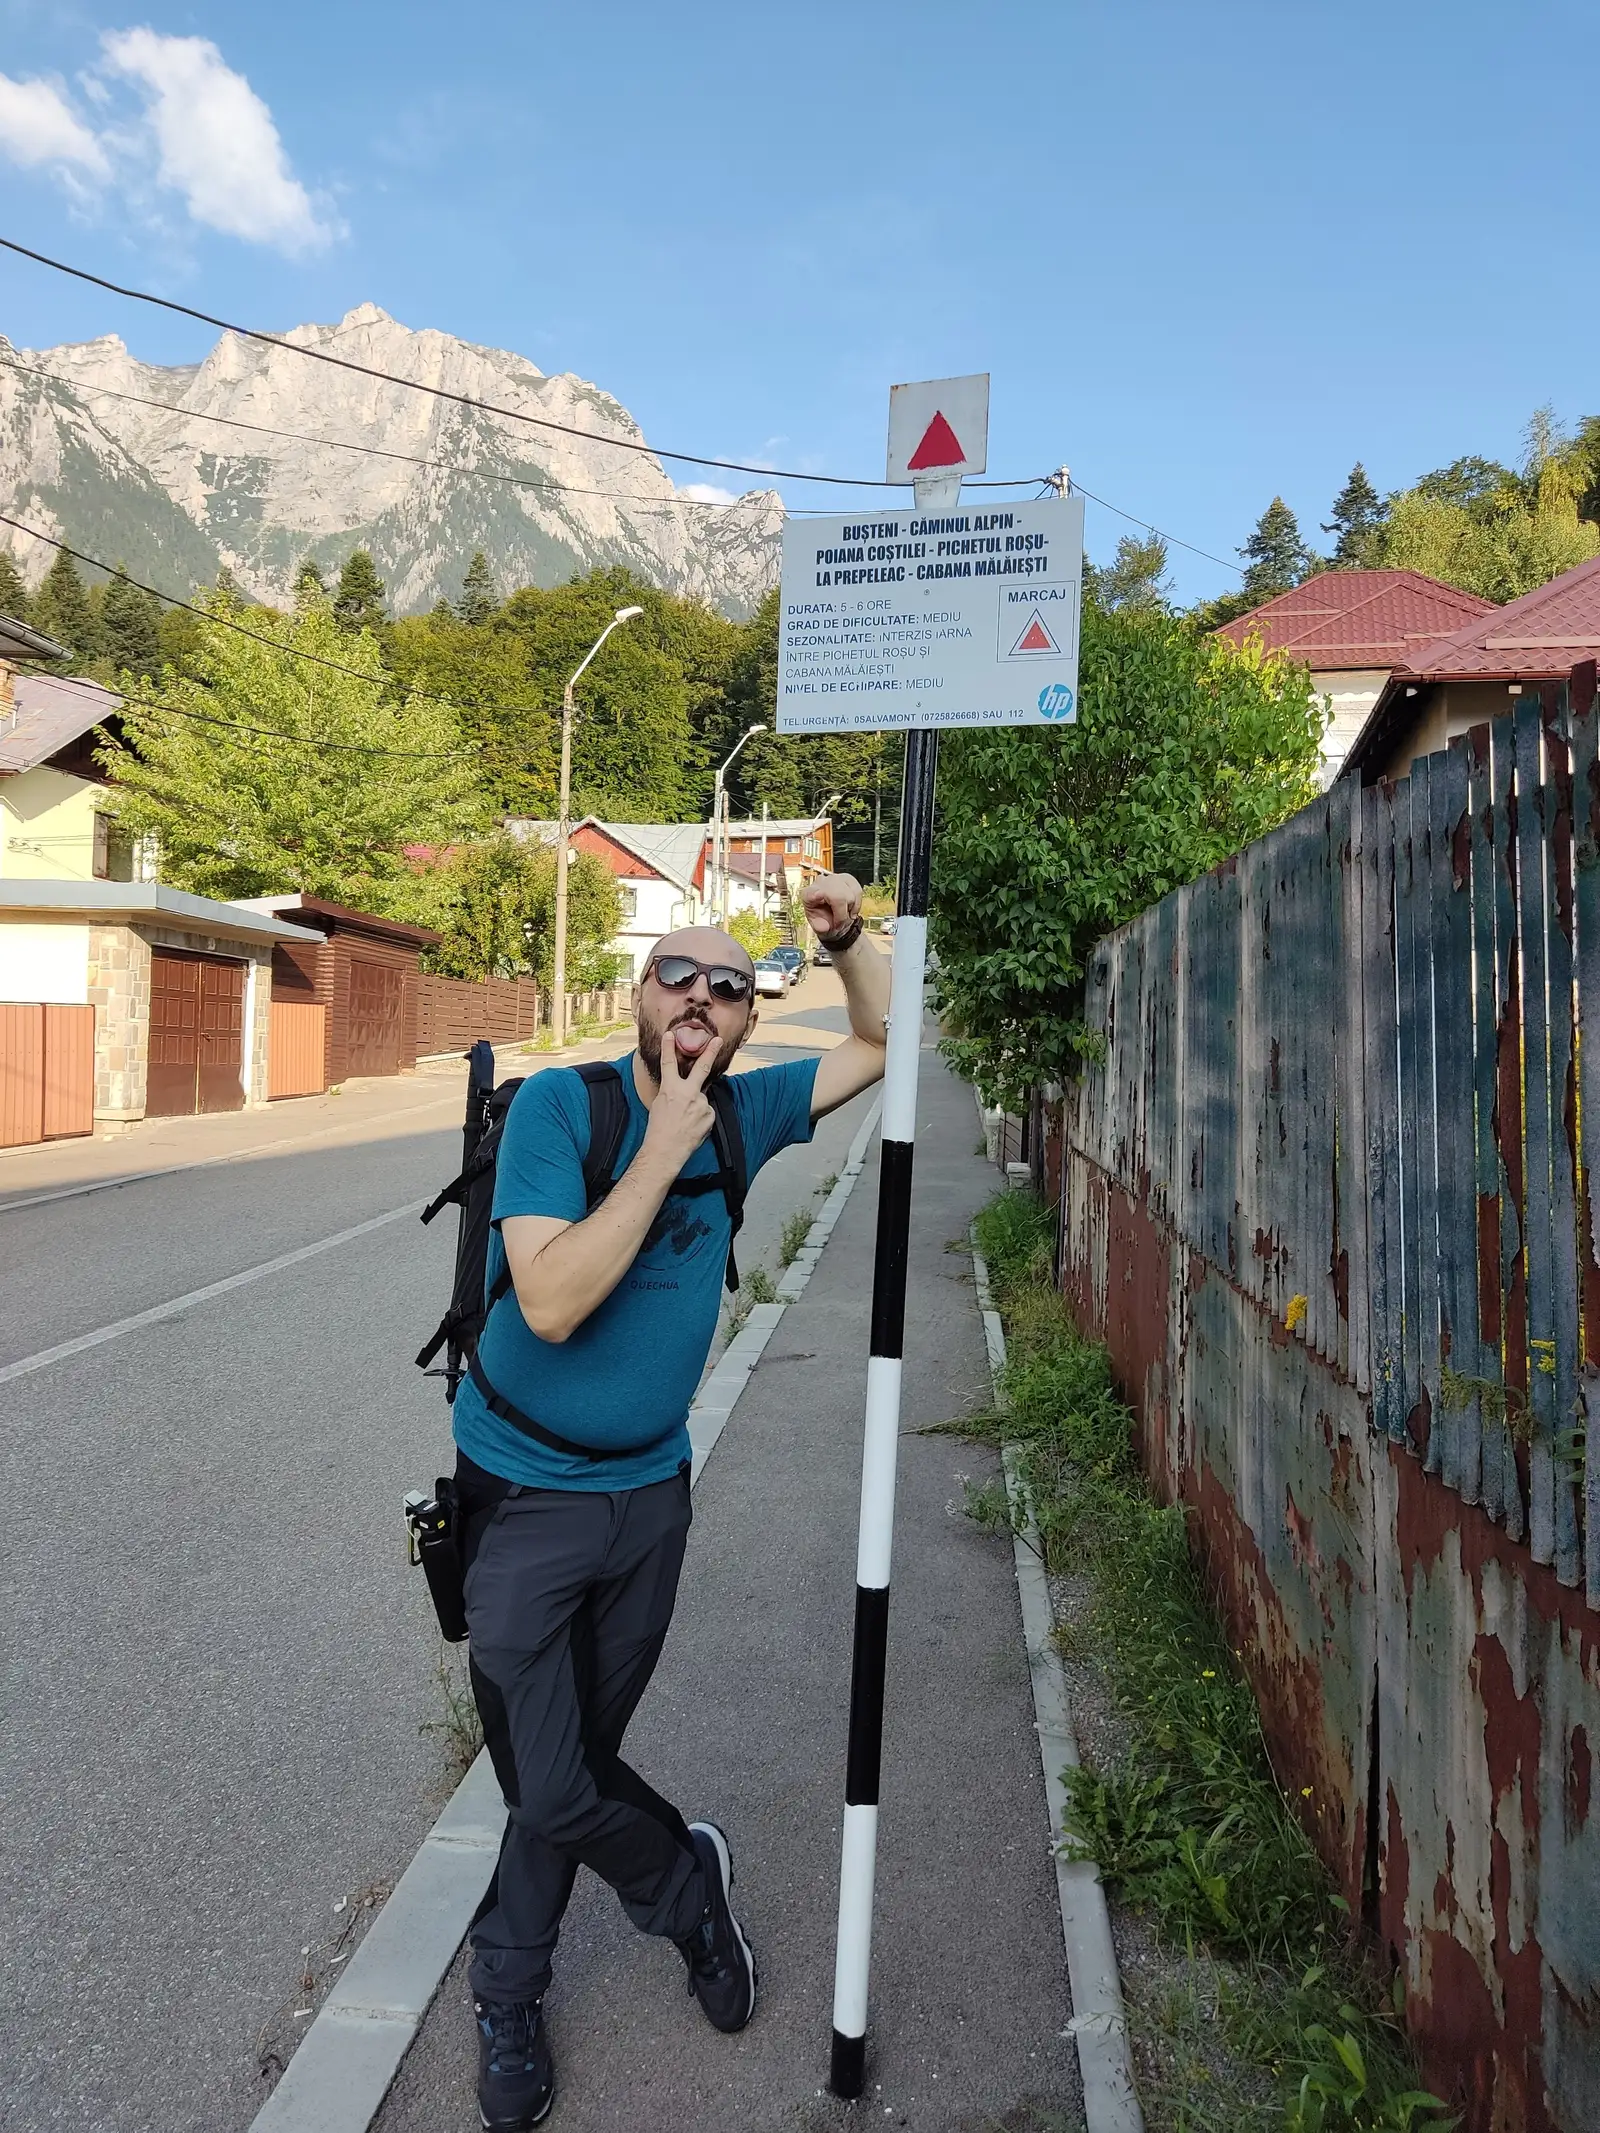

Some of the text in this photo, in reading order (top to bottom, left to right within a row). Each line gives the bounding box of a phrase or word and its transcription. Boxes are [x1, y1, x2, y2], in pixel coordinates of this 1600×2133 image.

[842, 522, 899, 544] BUȘTENI
[909, 517, 971, 536] CĂMINUL
[973, 513, 1014, 531] ALPIN
[816, 547, 865, 565] POIANA
[867, 542, 926, 564] COȘTILEI
[937, 537, 1002, 556] PICHETUL
[816, 571, 831, 586] LA
[834, 566, 905, 585] PREPELEAC
[916, 562, 971, 580] CABANA
[974, 556, 1048, 577] MĂLĂIEȘTI
[1008, 589, 1066, 602] MARCAJ
[788, 603, 837, 615] DURATA:
[840, 602, 847, 612] 5
[857, 601, 864, 611] 6
[867, 600, 892, 610] ORE
[787, 611, 961, 631] GRAD DE DIFICULTATE: MEDIU
[787, 632, 875, 647] SEZONALITATE:
[879, 629, 932, 642] INTERZIS
[785, 645, 930, 662] ÎNTRE PICHETUL ROȘU ȘI
[785, 663, 894, 679] CABANA MĂLĂIEȘTI
[785, 683, 818, 694] NIVEL
[821, 682, 837, 692] DE
[906, 677, 944, 689] MEDIU
[1039, 684, 1072, 720] hp
[921, 711, 980, 722] (0725826668)
[982, 710, 1003, 719] SAU
[1009, 709, 1024, 718] 112
[630, 1280, 680, 1290] QUECHUA
